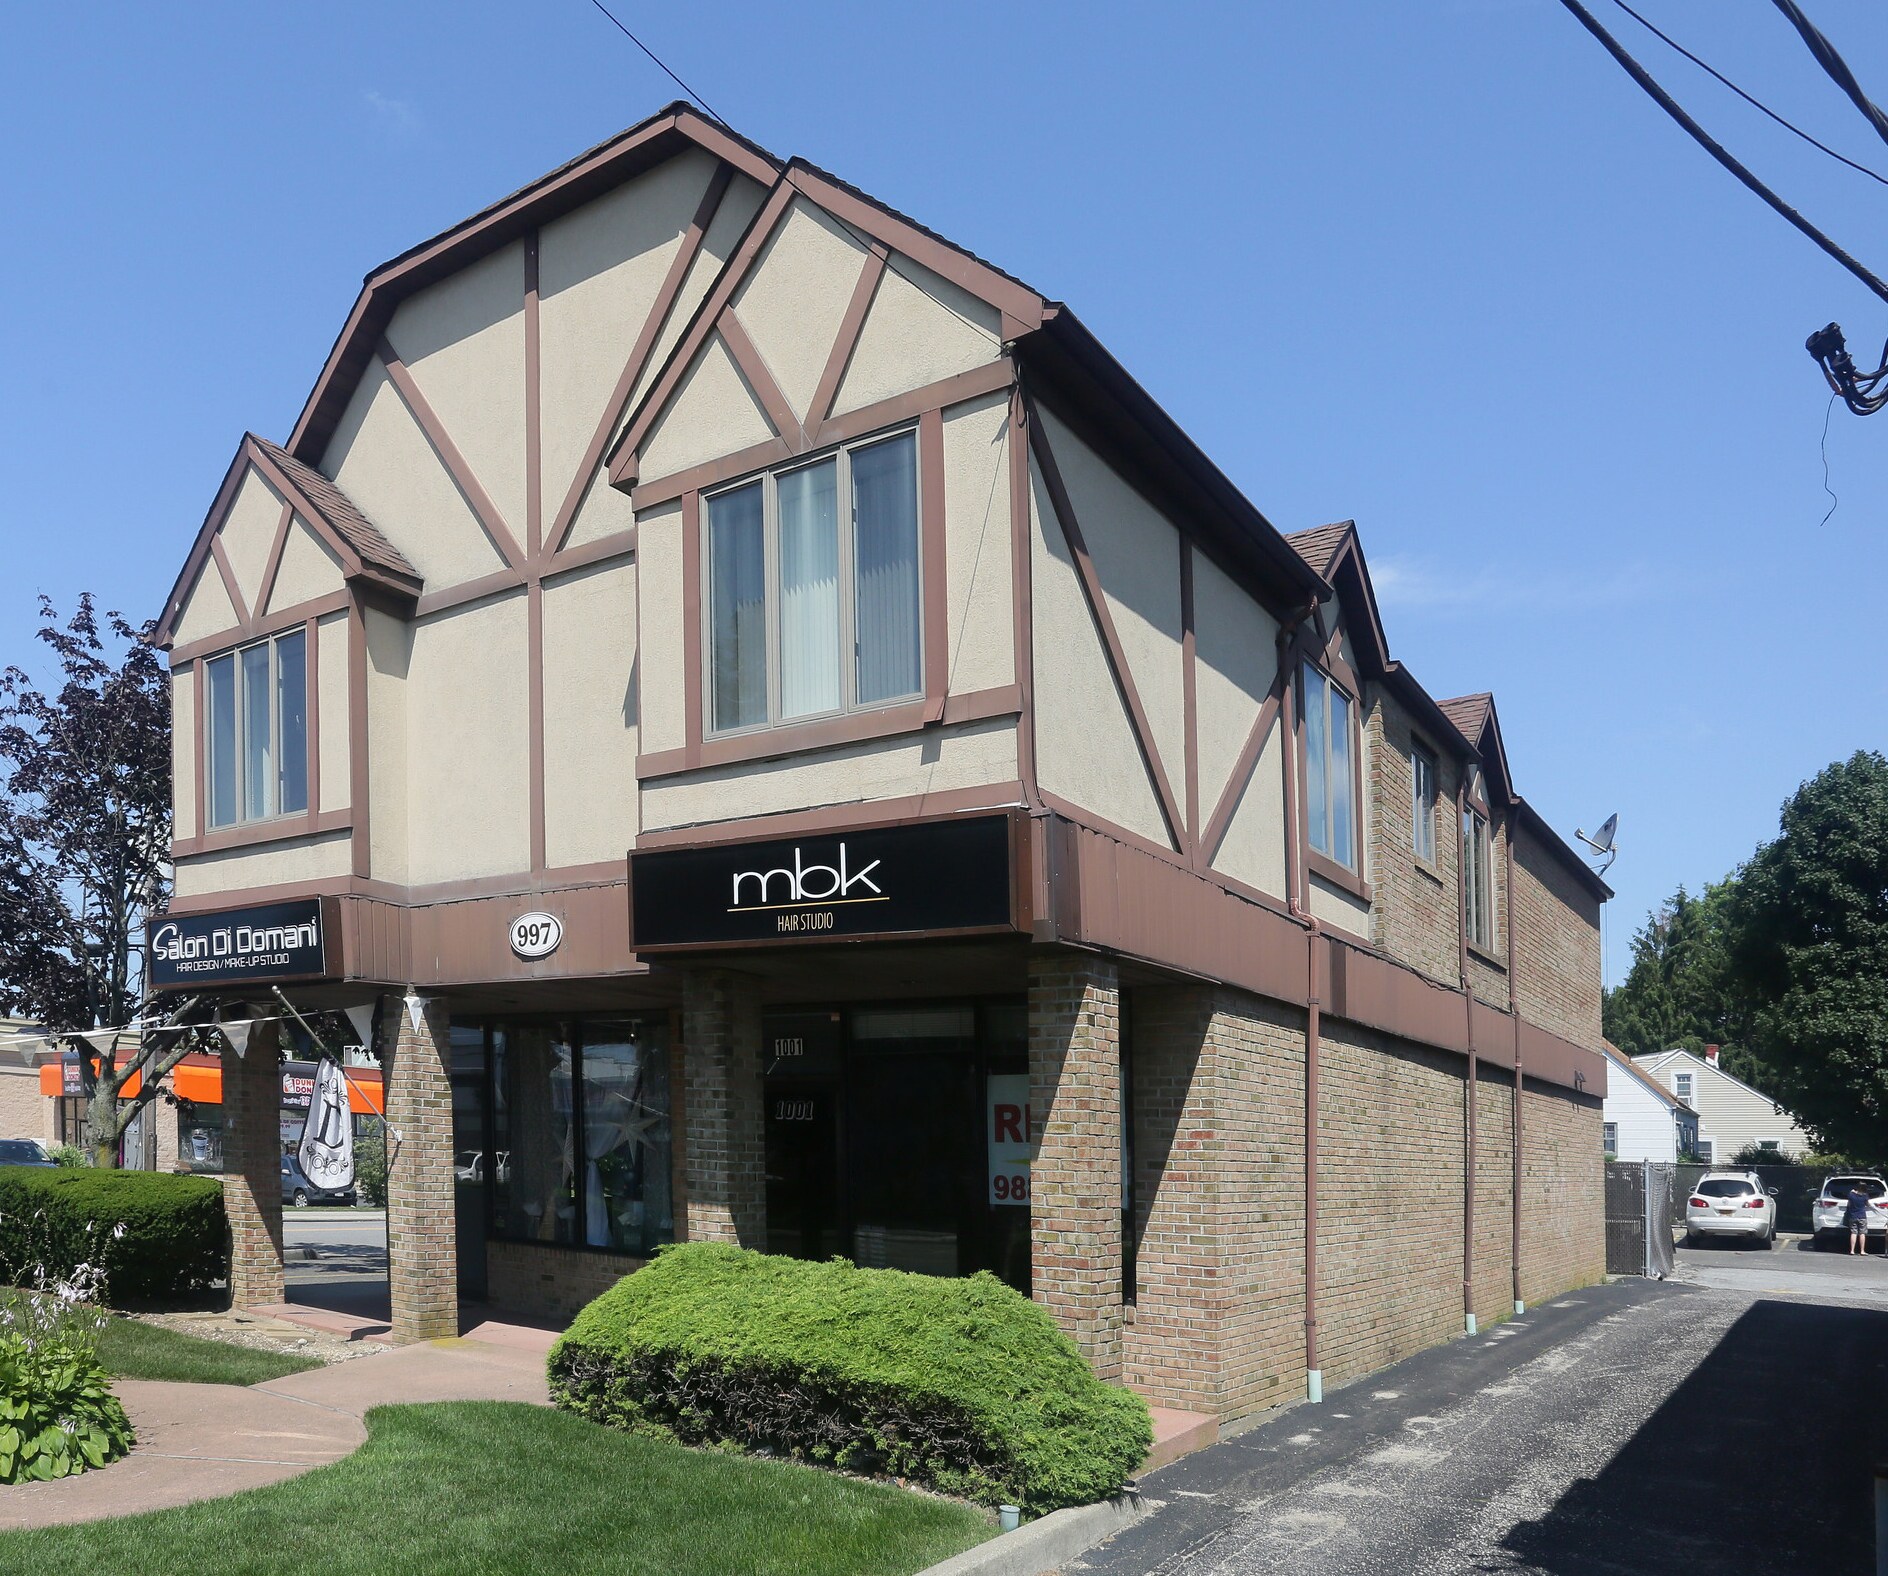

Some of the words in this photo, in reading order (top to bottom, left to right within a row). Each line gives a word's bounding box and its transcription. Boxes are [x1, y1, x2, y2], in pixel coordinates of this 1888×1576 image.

[733, 842, 882, 905] mbk
[777, 915, 799, 932] HAIR
[800, 912, 834, 930] STUDIO
[152, 922, 208, 961] Salon
[212, 926, 232, 956] Di
[236, 916, 318, 953] Domani
[517, 922, 551, 947] 997
[176, 962, 193, 973] HAIR
[224, 956, 260, 969] MAKE-UP
[261, 952, 289, 966] STUDIO
[777, 1039, 802, 1055] 1001
[776, 1099, 814, 1121] 1001
[993, 1174, 1031, 1201] 98
